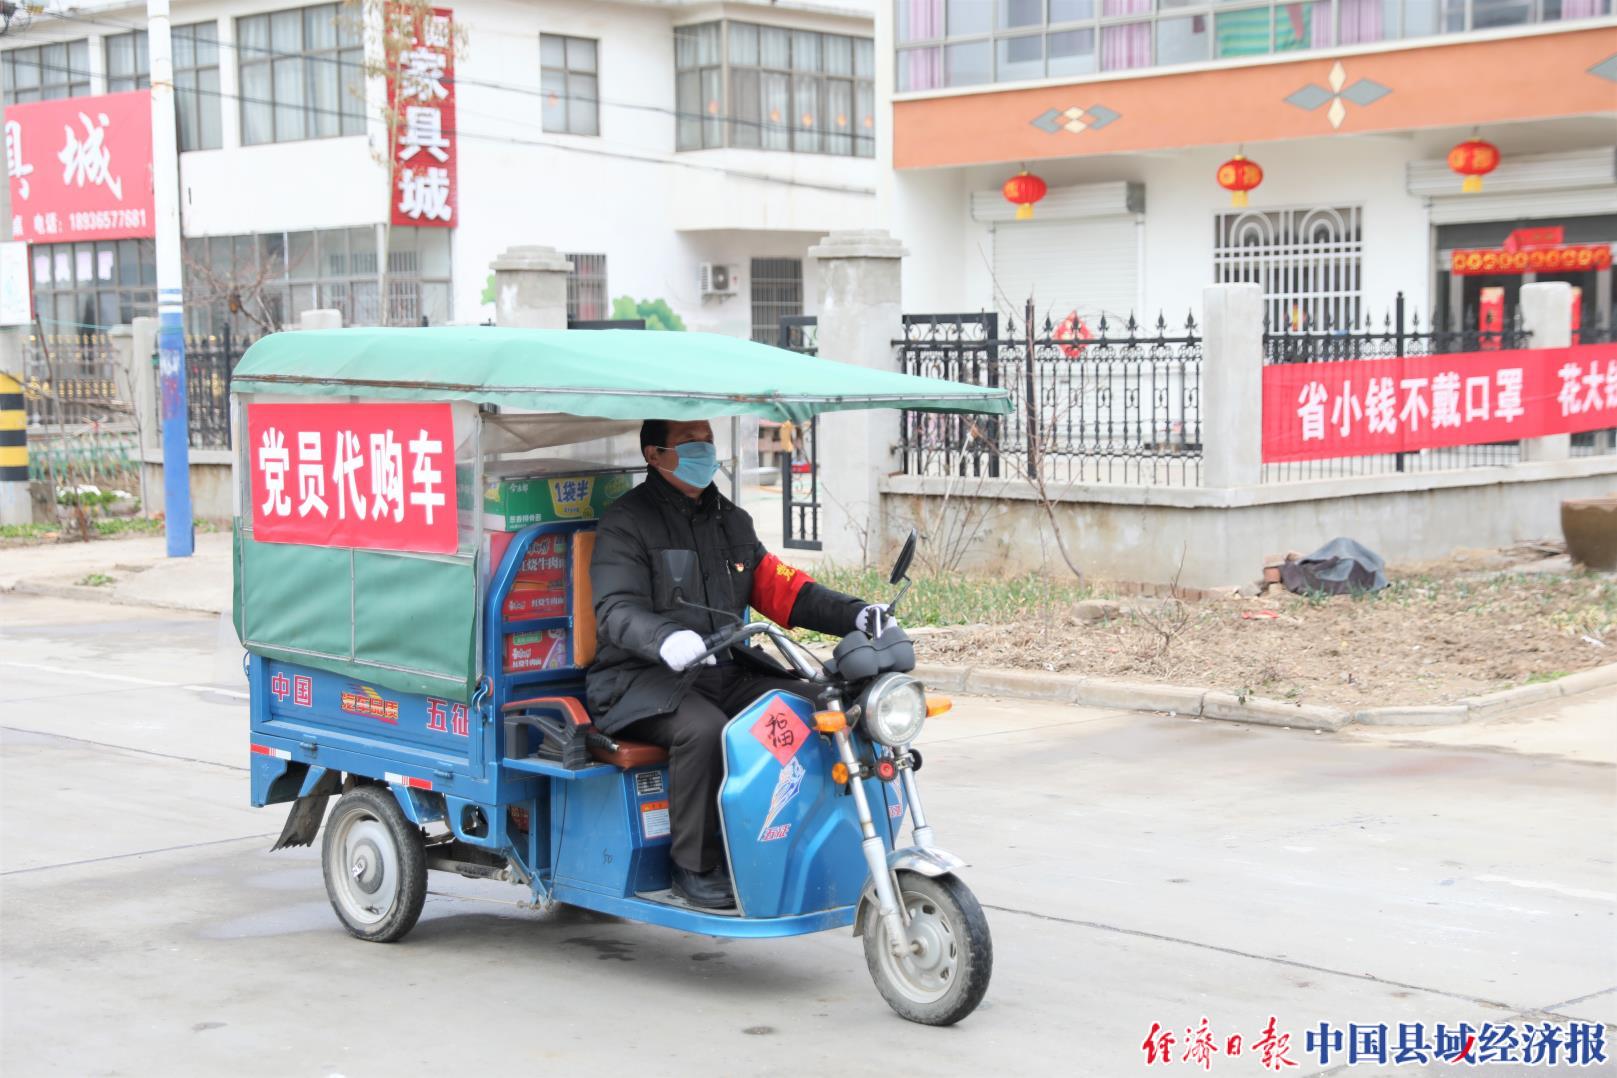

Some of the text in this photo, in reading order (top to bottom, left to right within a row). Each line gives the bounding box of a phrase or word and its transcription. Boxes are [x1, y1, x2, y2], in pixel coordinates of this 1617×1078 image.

[1297, 368, 1526, 442] 省小钱不戴口罩
[258, 426, 446, 525] 党员代购车
[555, 480, 589, 502] 1袋半
[271, 671, 313, 708] 中国
[765, 713, 795, 748] 福
